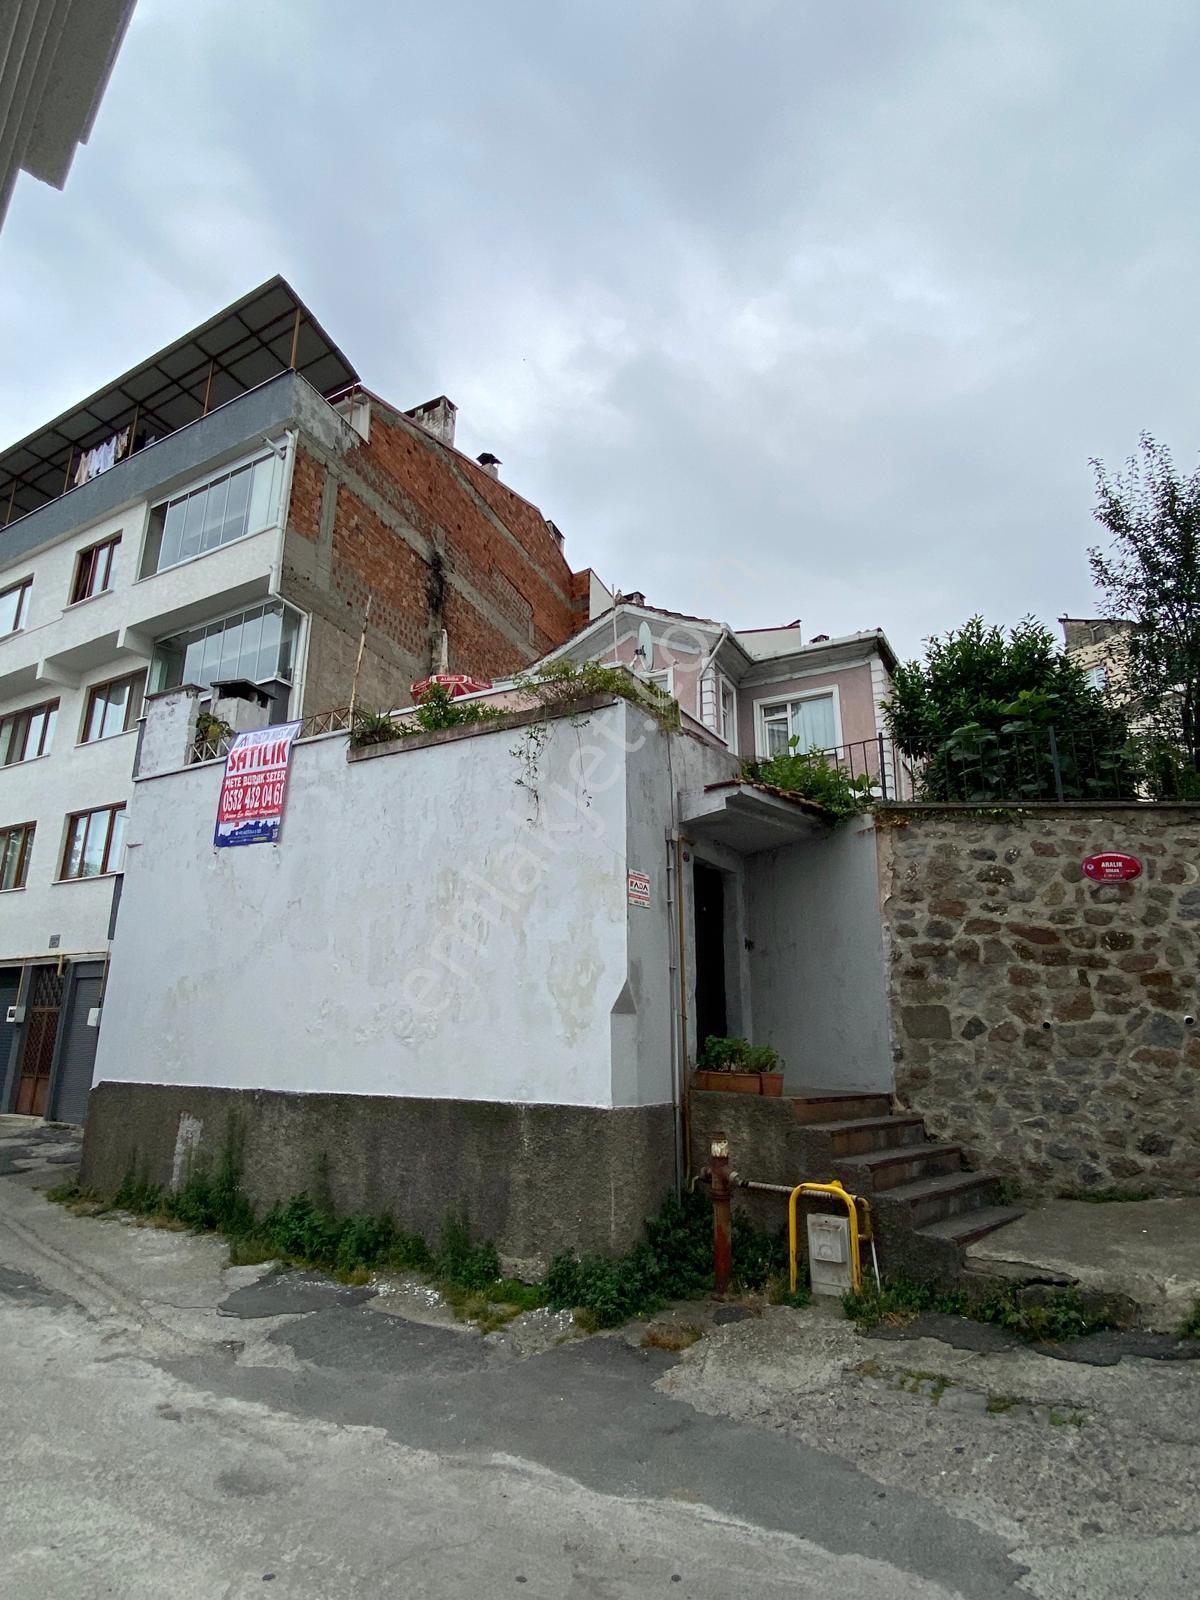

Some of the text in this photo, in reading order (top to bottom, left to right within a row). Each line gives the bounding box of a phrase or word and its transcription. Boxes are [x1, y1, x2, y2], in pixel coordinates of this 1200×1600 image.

[229, 741, 287, 772] SATILIK
[224, 776, 242, 789] METE
[222, 789, 243, 812] 0532
[245, 787, 260, 809] 432
